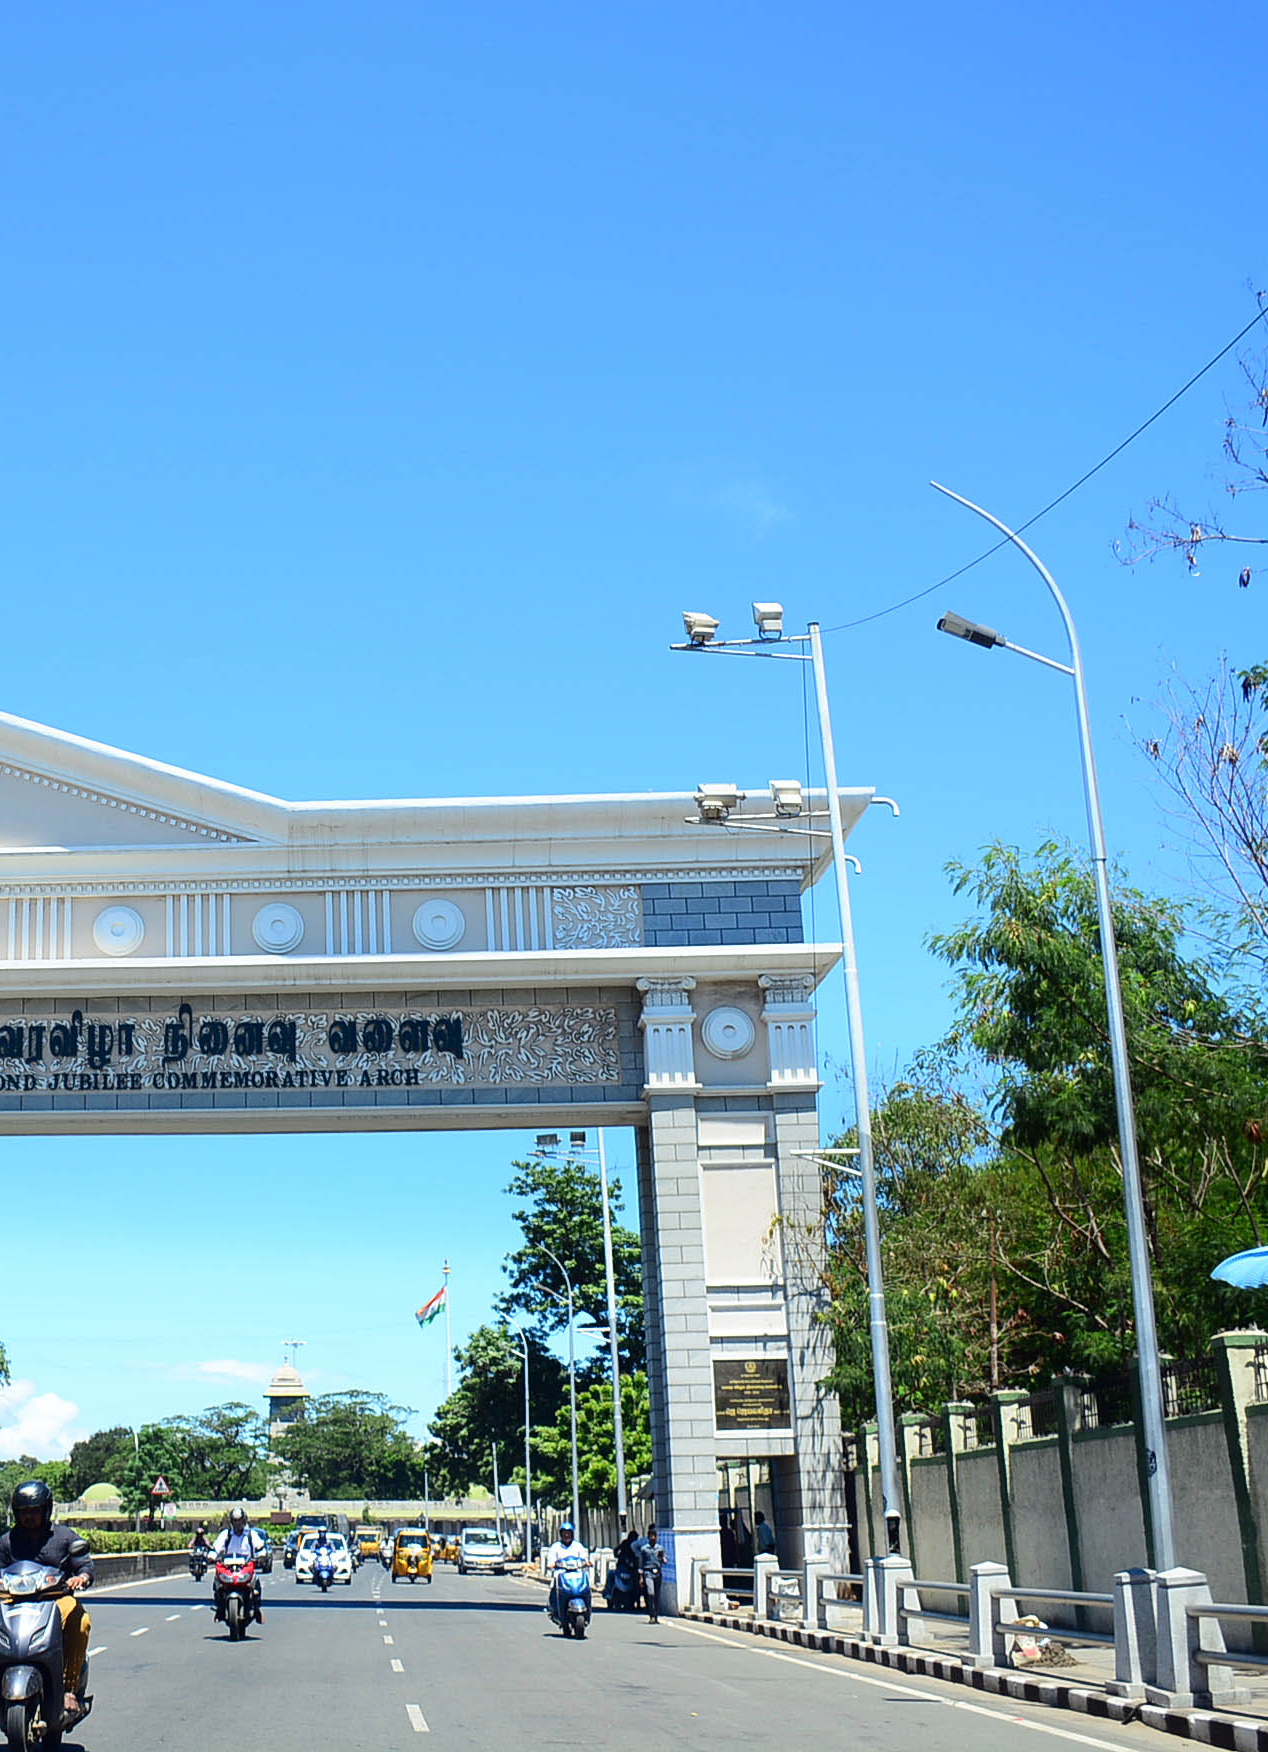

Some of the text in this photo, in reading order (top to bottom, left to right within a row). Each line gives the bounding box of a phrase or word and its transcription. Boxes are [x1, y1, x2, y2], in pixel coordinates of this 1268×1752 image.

[162, 1003, 298, 1069] நினைவு
[328, 1017, 464, 1060] வளைவு
[47, 1072, 143, 1092] JUBILEE
[152, 1070, 350, 1089] COMMEMORATIVE
[358, 1067, 421, 1087] ARCH
